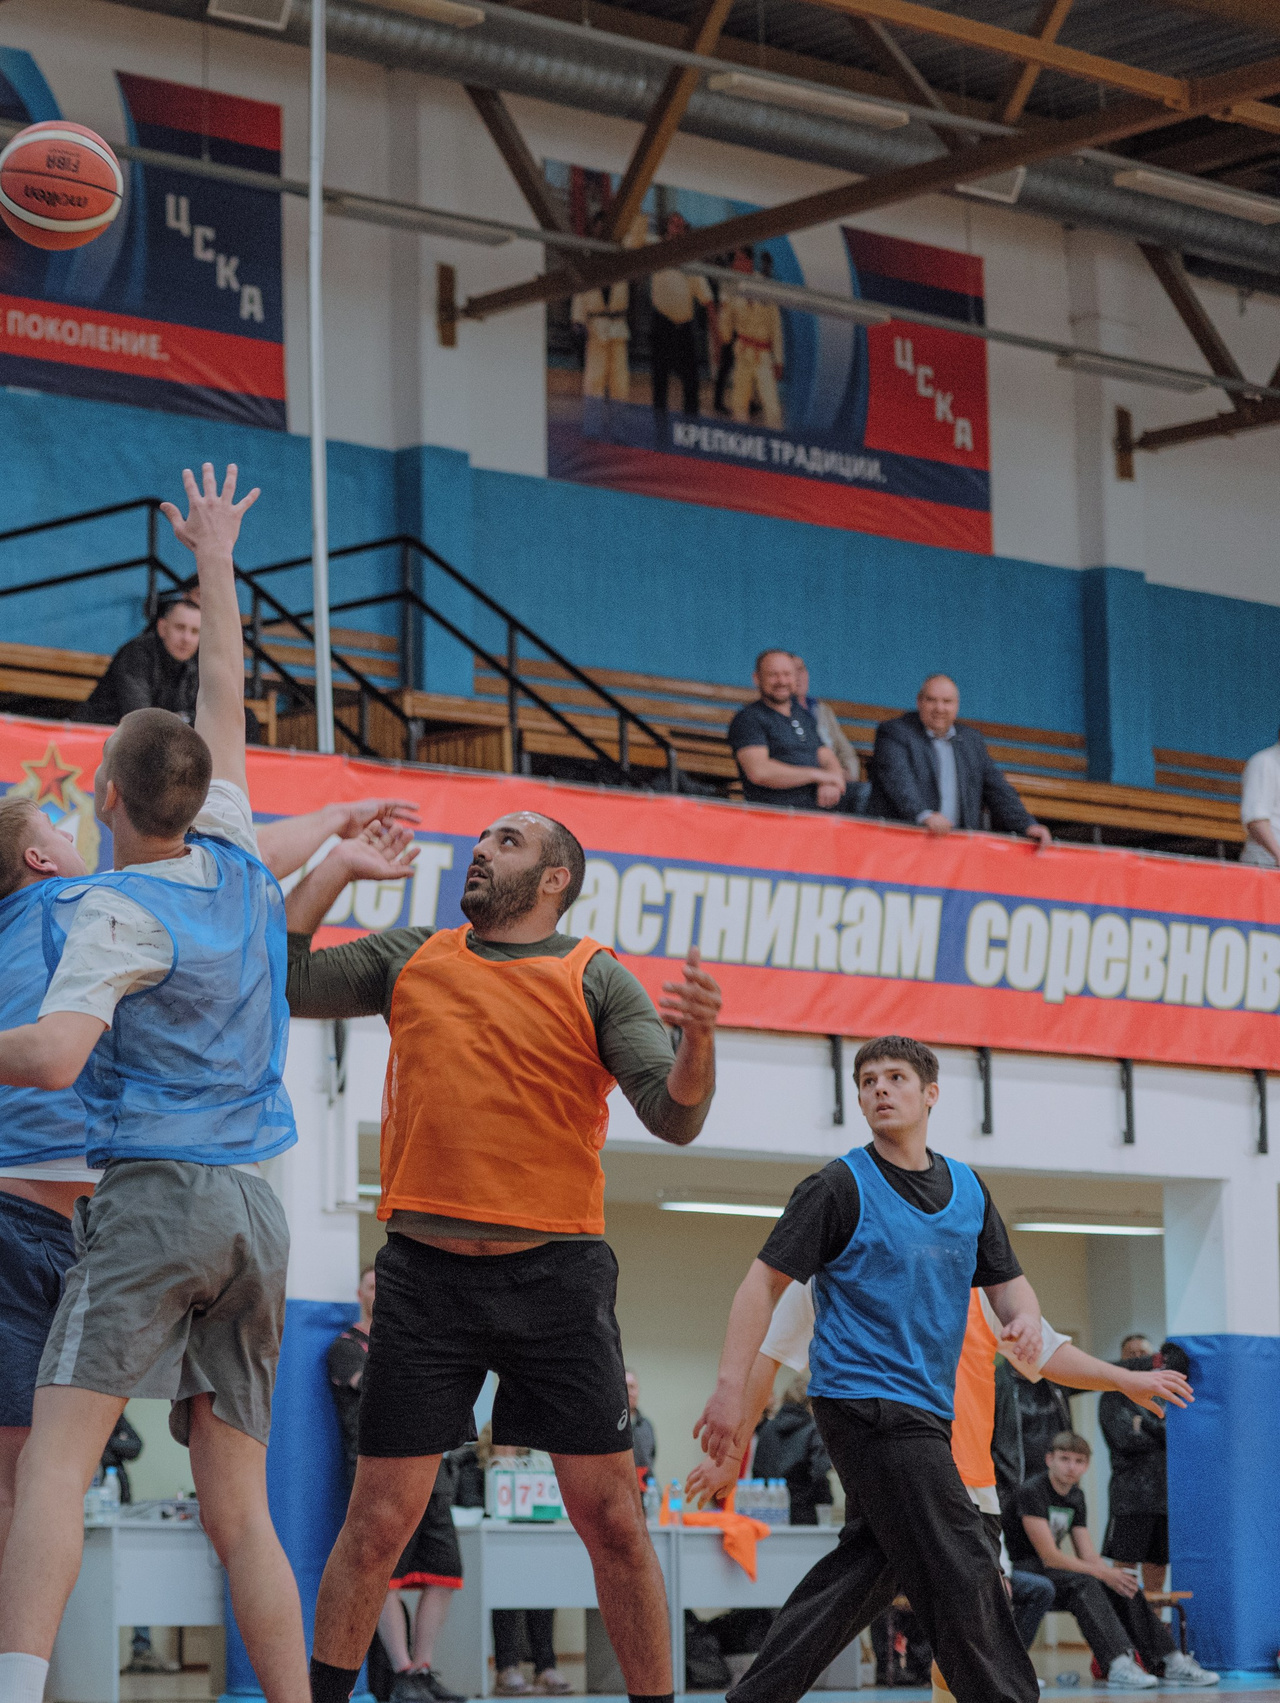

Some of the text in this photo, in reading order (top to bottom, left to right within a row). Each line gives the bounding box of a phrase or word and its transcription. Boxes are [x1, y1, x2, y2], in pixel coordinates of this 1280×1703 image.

[166, 193, 264, 323] ЦСКА
[6, 309, 170, 362] ПОКОЛЕНИЕ.
[894, 337, 974, 452] ЦСКА
[672, 422, 888, 484] КРЕПКИЕ ТРАДИЦИИ.
[556, 858, 943, 982] астникам
